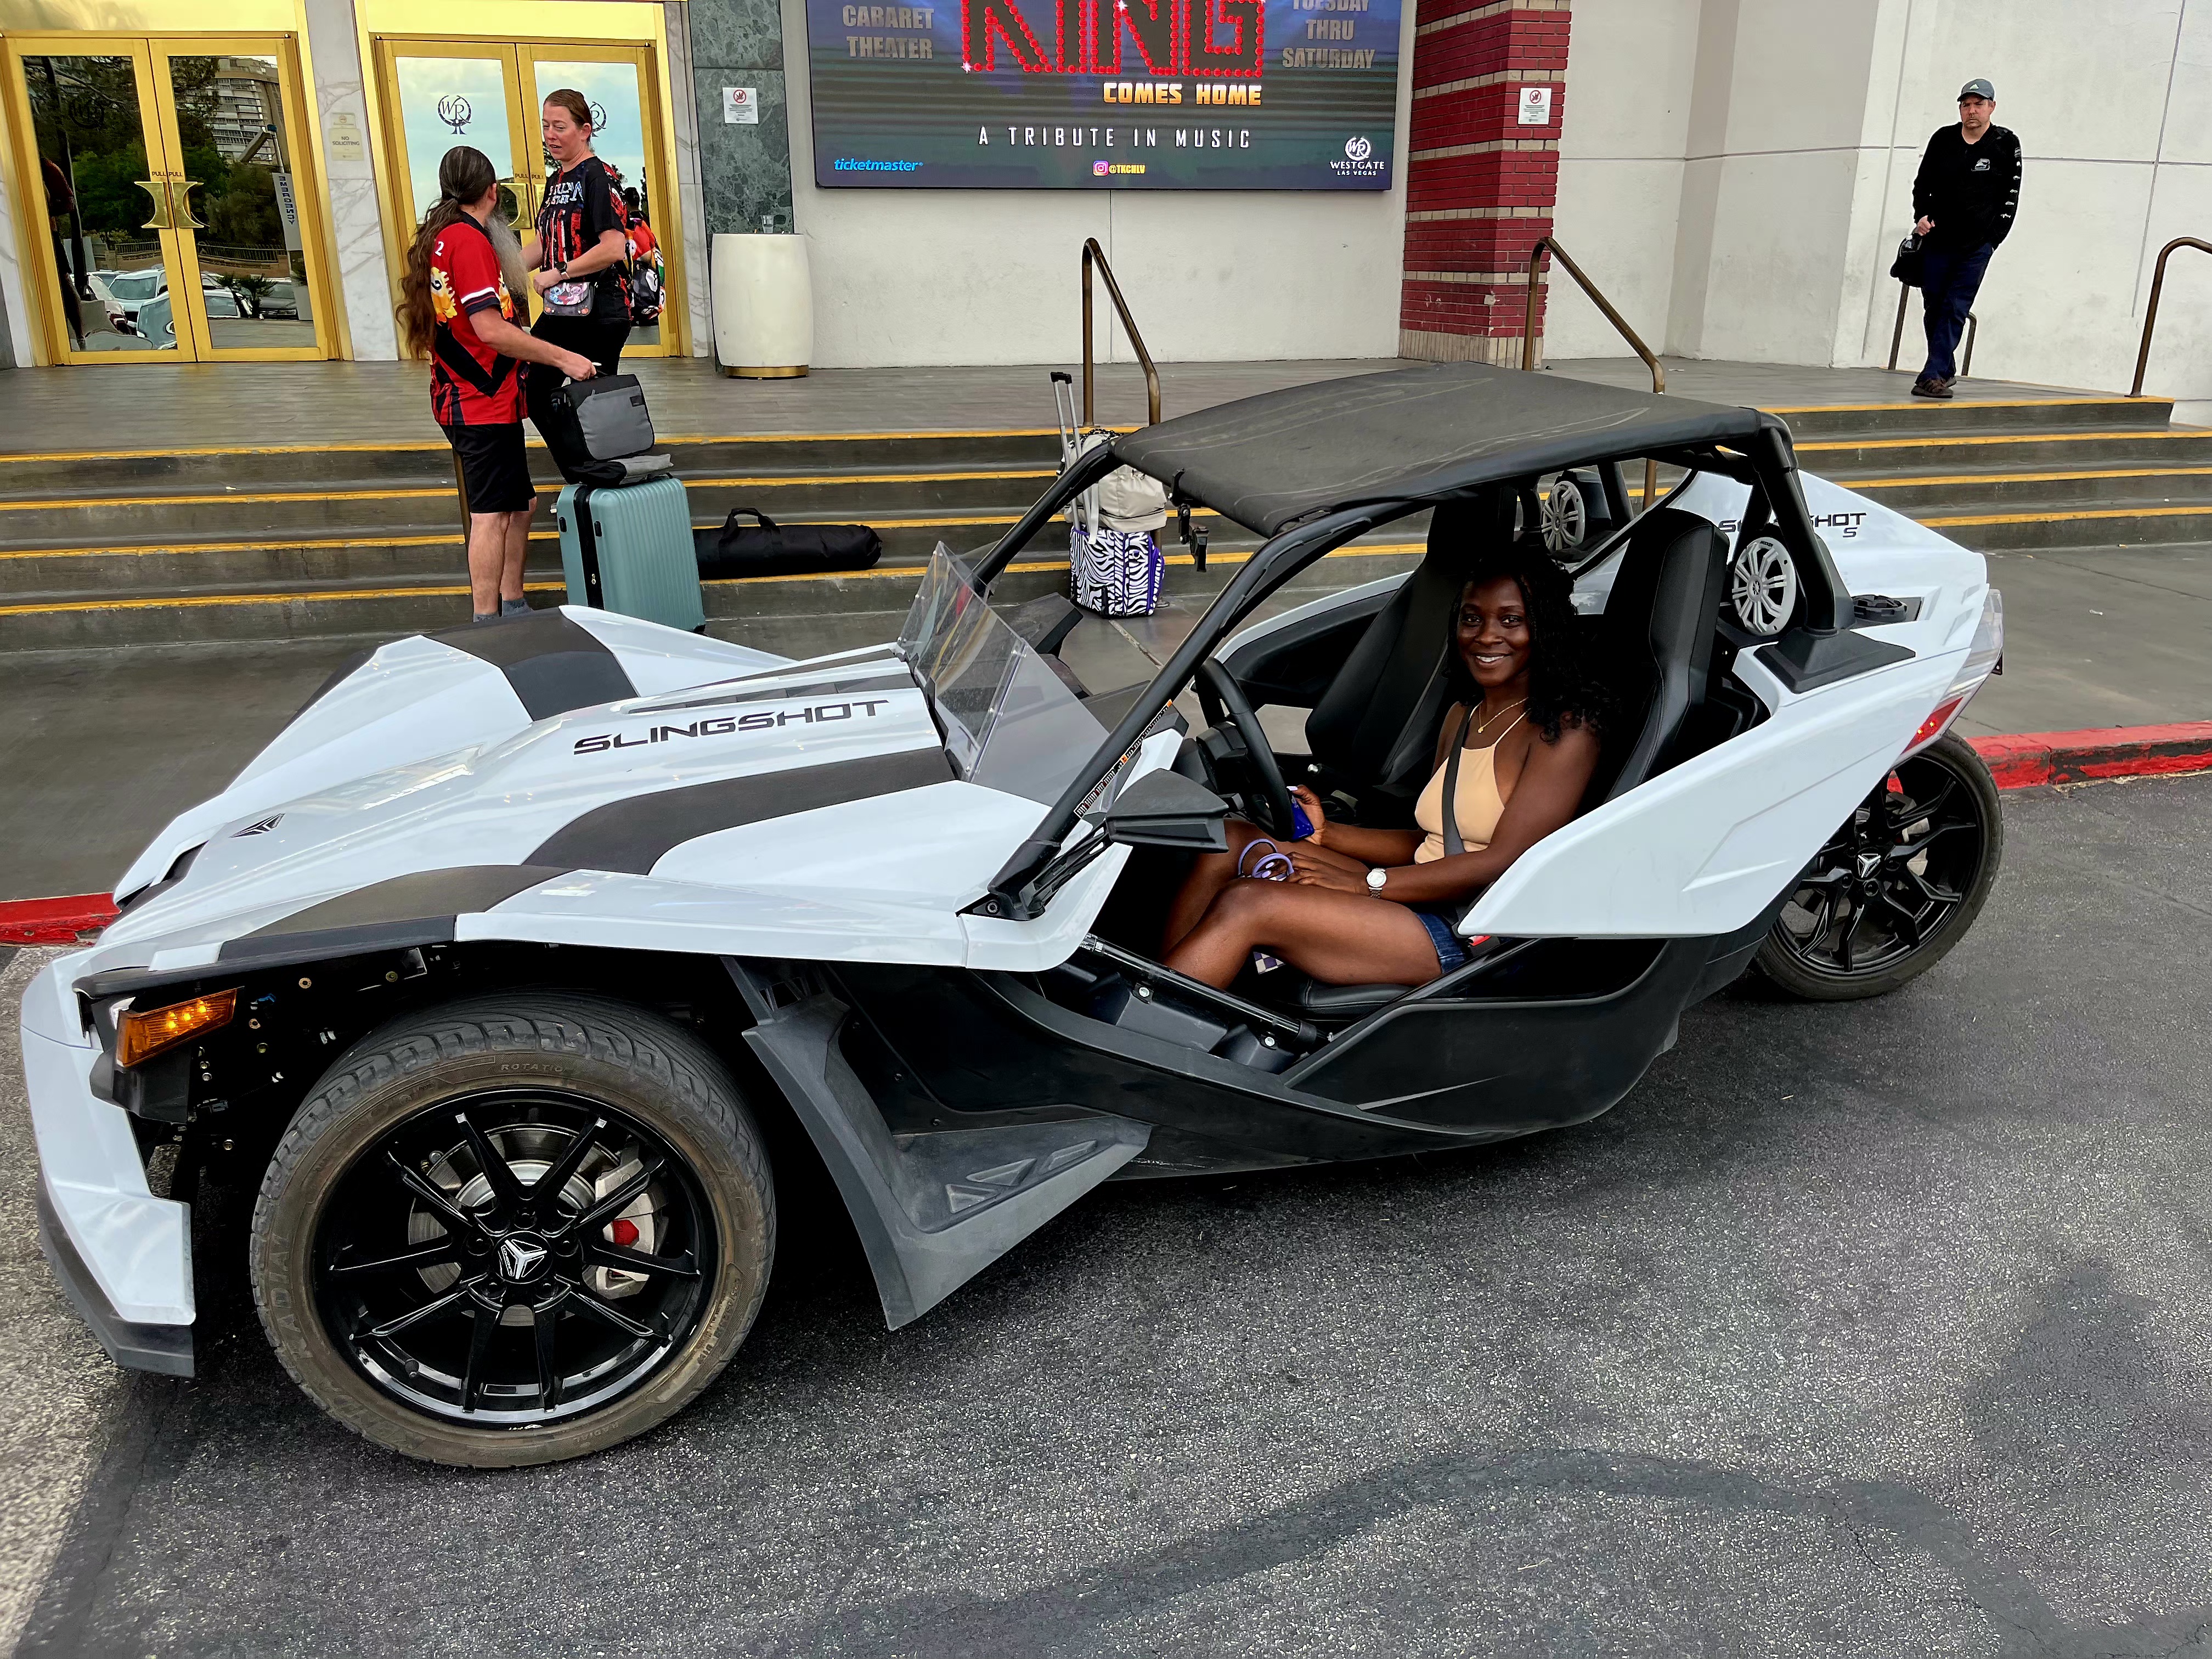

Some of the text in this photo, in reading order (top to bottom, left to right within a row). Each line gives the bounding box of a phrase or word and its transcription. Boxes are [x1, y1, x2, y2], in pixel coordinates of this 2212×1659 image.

[843, 5, 934, 29] CABARET
[1306, 19, 1354, 40] THRU
[847, 36, 933, 59] THEATER
[1282, 48, 1375, 69] SATURDAY
[1103, 82, 1262, 106] COMES HOME
[979, 126, 1250, 148] A TRIBUTE IN MUSIC
[1345, 136, 1372, 161] WR
[834, 157, 919, 172] ticketmaster
[1329, 161, 1385, 170] WESTGATE
[1842, 527, 1858, 538] S
[573, 699, 890, 755] SLINGSHOT
